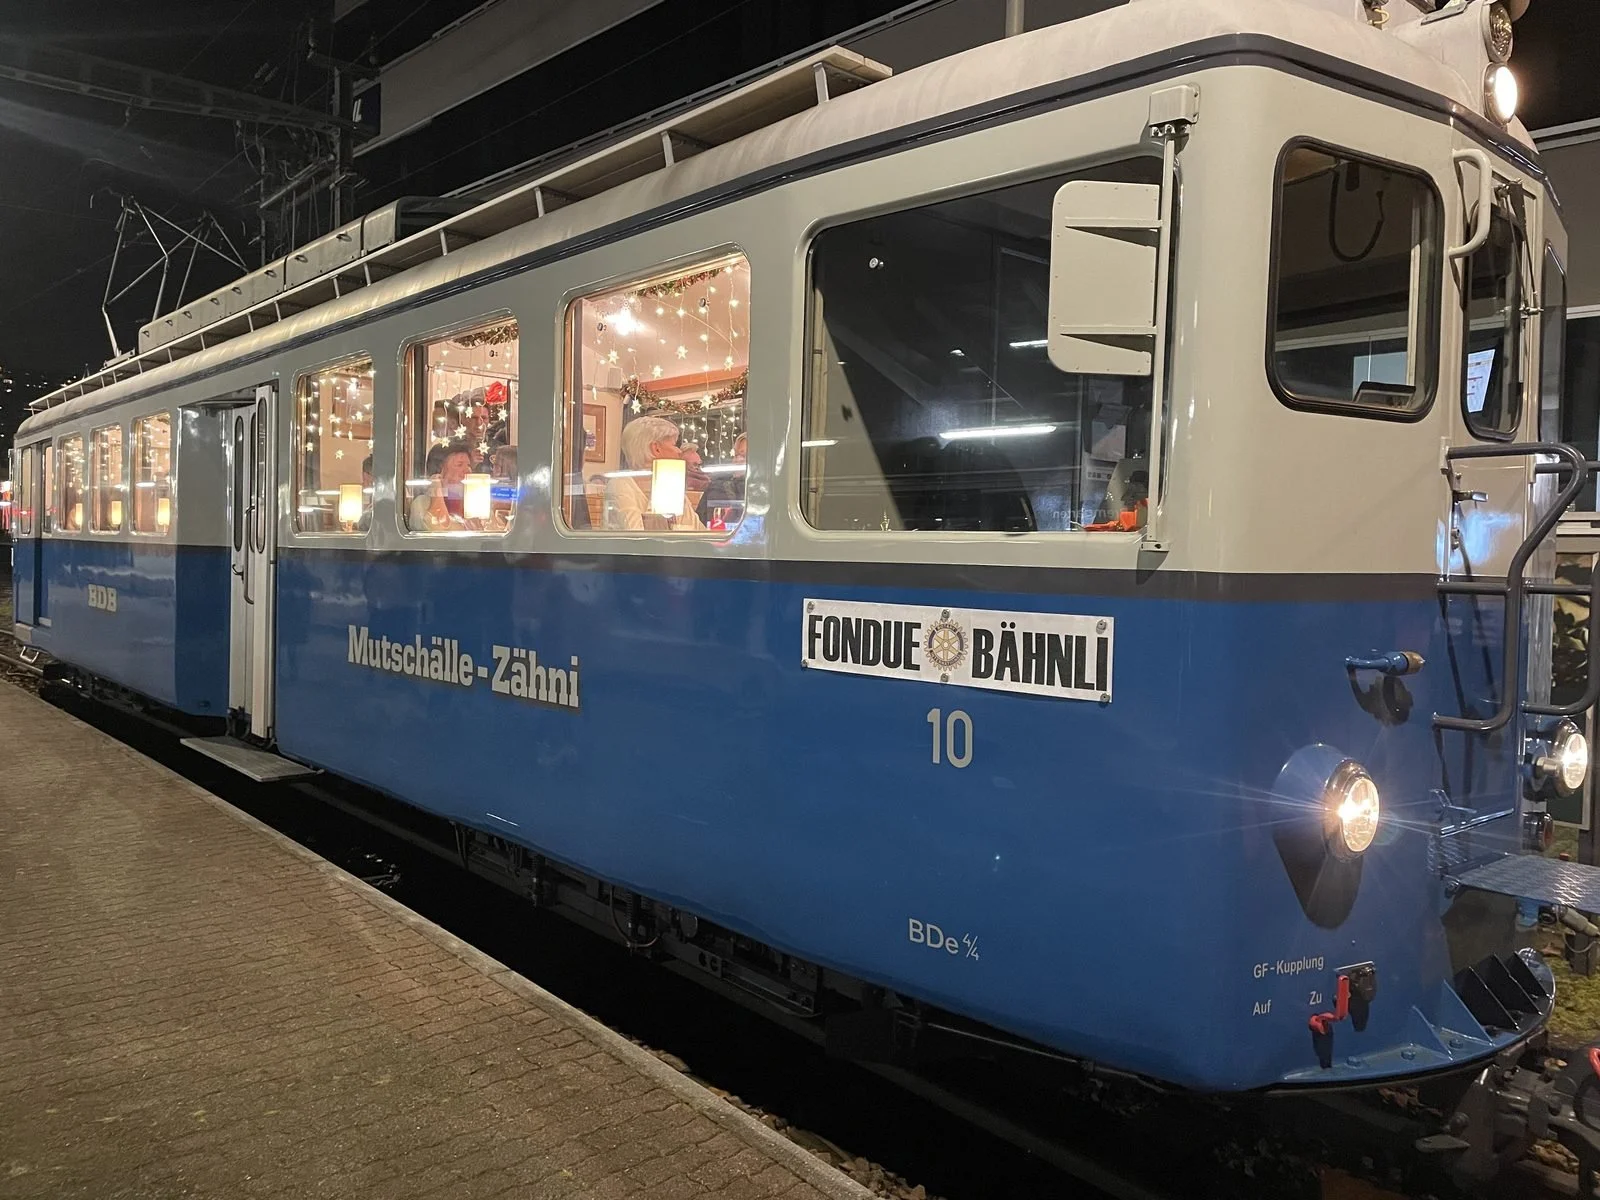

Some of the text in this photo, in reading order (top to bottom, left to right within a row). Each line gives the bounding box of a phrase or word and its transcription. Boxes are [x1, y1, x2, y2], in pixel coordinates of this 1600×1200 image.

[88, 583, 117, 612] BDB
[348, 624, 579, 708] Mutschälle-Zähni
[808, 614, 1109, 692] FONDUE BÄHNLI
[927, 708, 973, 769] 10
[908, 918, 959, 955] BDe
[1253, 956, 1324, 979] GF-Kupplung
[1252, 999, 1272, 1016] Auf
[1309, 990, 1322, 1005] Zu
